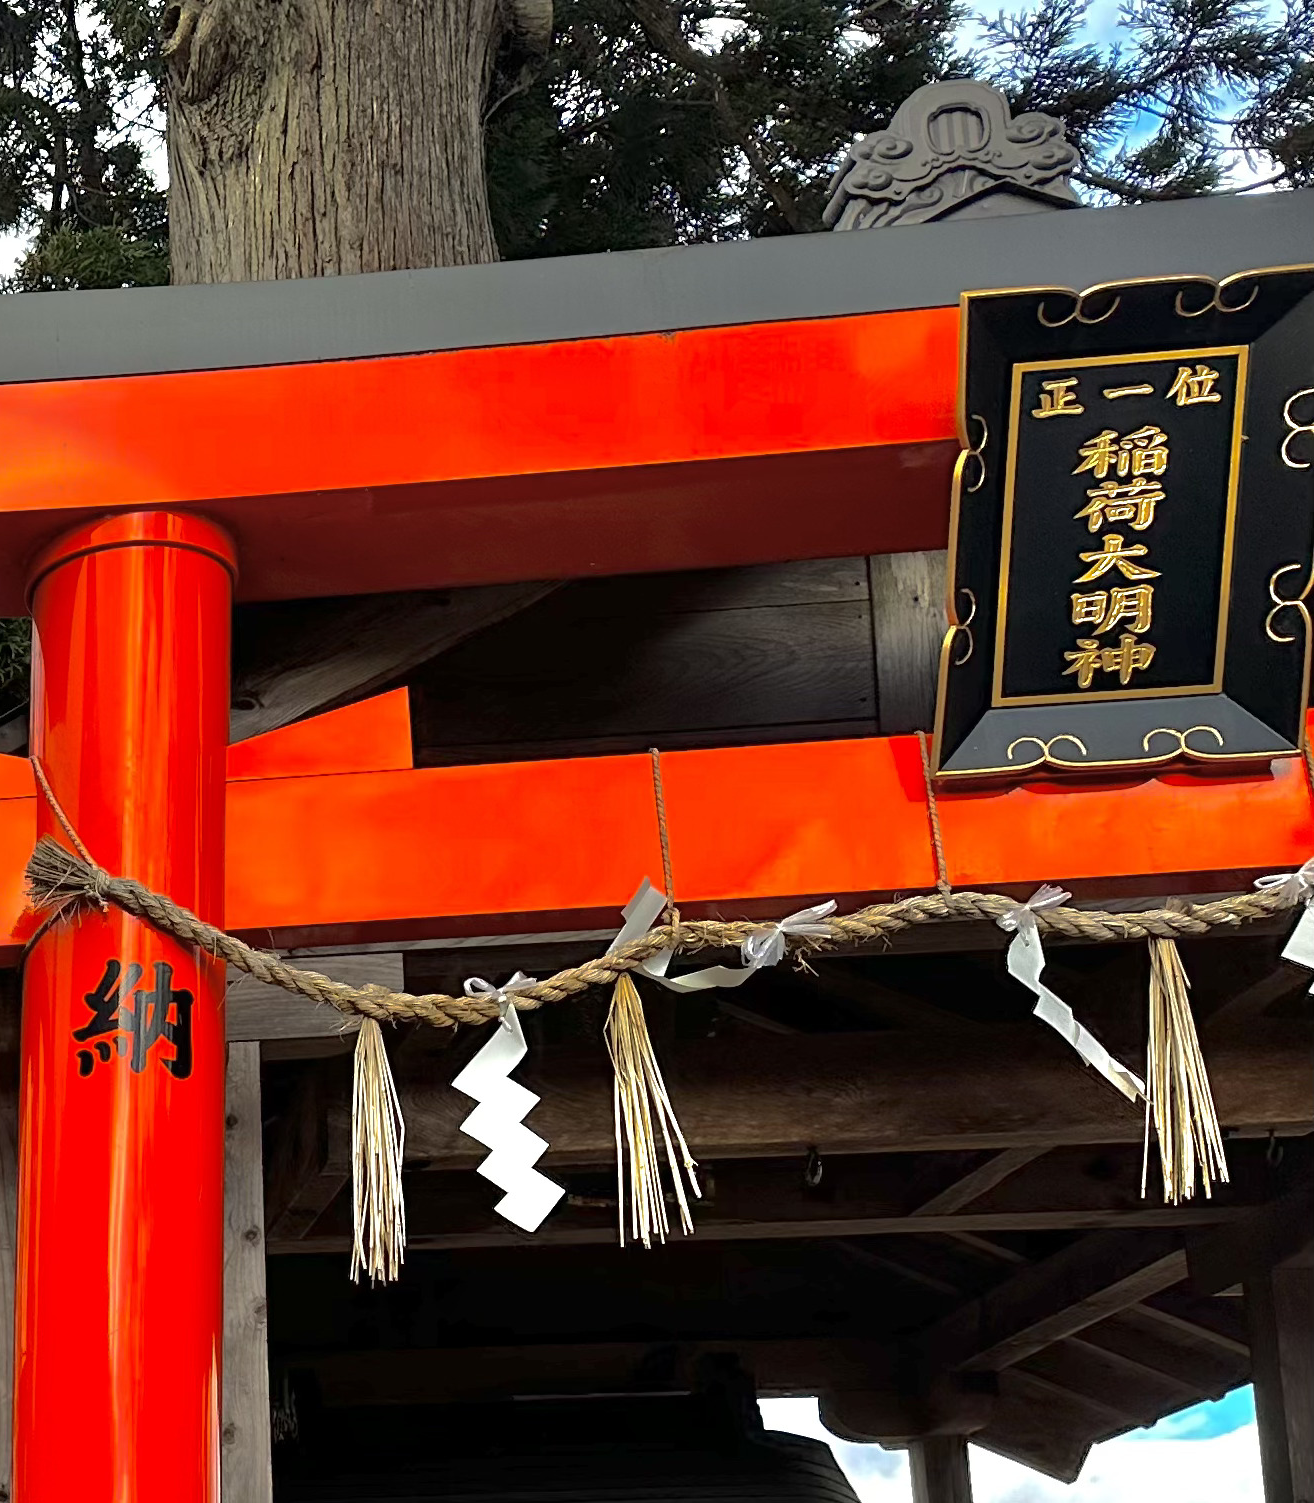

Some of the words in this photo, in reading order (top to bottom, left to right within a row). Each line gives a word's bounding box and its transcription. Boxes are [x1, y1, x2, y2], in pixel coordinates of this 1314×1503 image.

[1031, 365, 1222, 419] 正一位
[1063, 425, 1170, 689] 稲荷大明神
[73, 959, 194, 1079] 納
